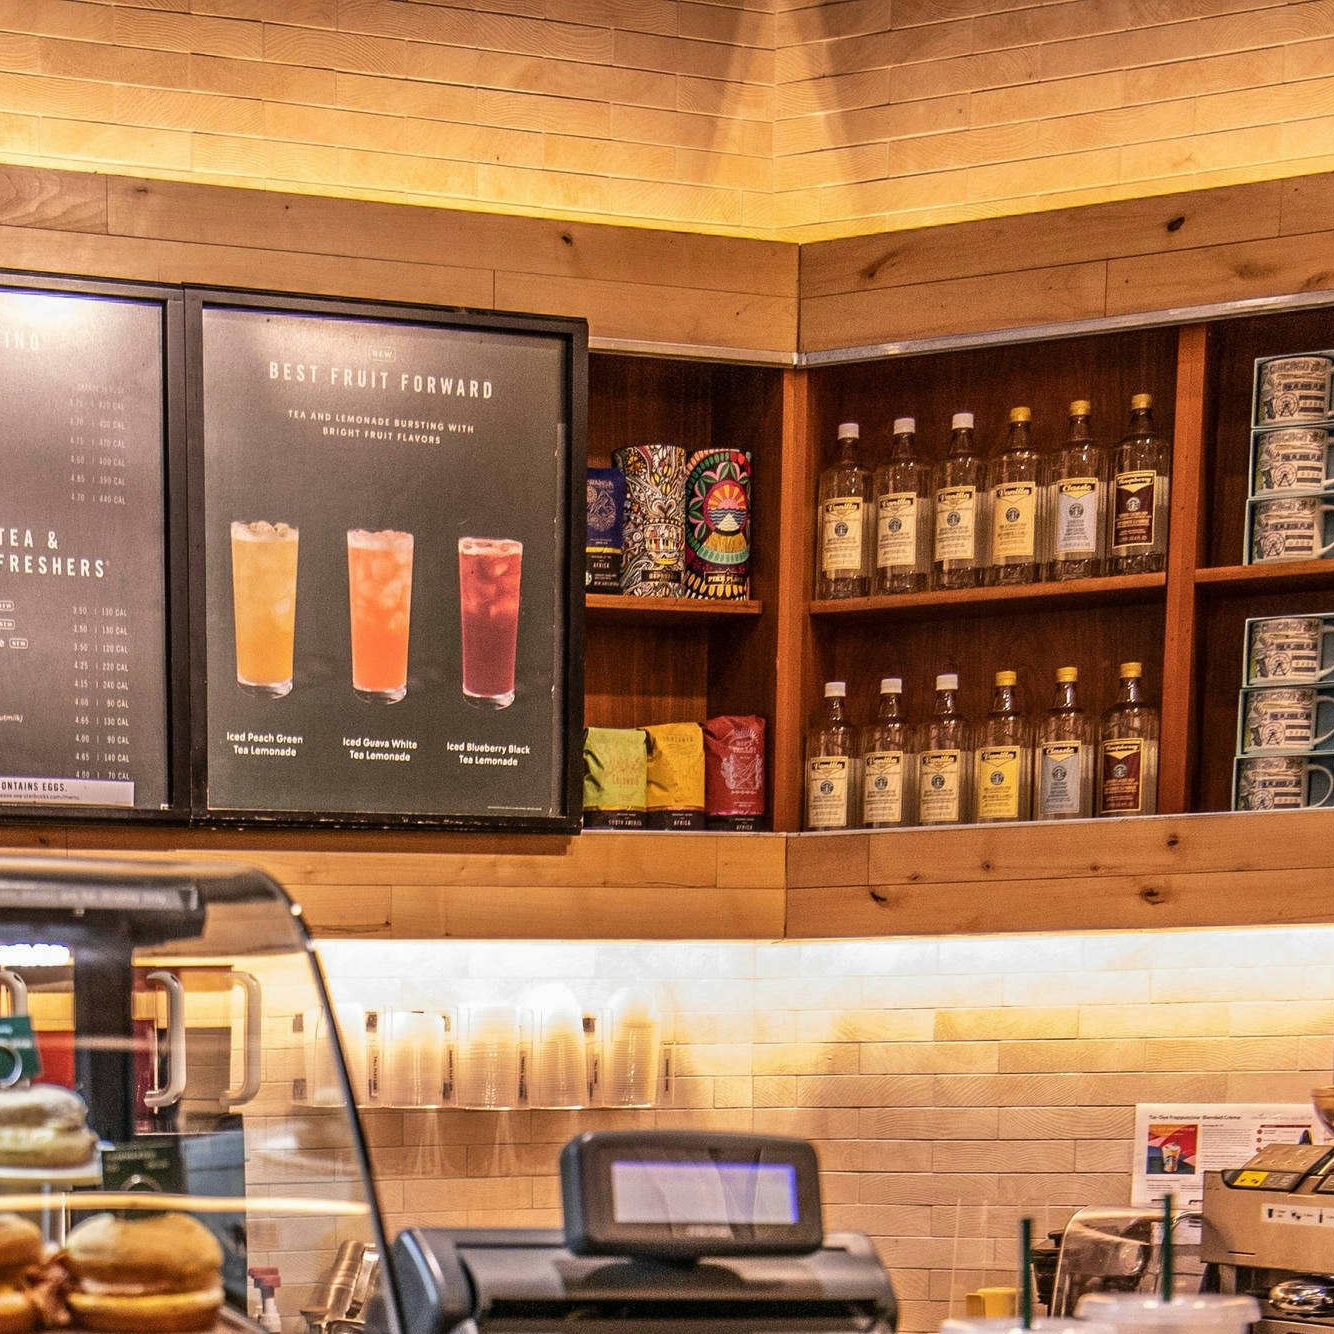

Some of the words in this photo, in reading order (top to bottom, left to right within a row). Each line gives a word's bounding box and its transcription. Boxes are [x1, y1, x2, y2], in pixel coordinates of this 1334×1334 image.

[269, 361, 318, 382] BEST
[330, 368, 388, 389] FRUIT
[401, 374, 492, 398] FORWARD
[288, 408, 306, 419] TEA
[310, 411, 331, 421] AND
[335, 413, 389, 426] LEMONADE
[394, 418, 443, 431] BURSTING
[447, 423, 473, 433] WITH
[322, 425, 360, 437] BRIGHT
[364, 429, 392, 440] FRUIT
[397, 432, 440, 444] FLAVORS
[47, 530, 58, 549] &
[226, 731, 245, 741] Iced
[247, 732, 274, 742] Peach
[275, 733, 303, 744] Green
[342, 736, 361, 746] Iced
[362, 737, 389, 747] Guava
[391, 738, 417, 749] White
[232, 744, 248, 754] Tea
[250, 745, 296, 756] Lemonade
[446, 741, 464, 751] Iced
[466, 742, 506, 755] Blueberry
[508, 744, 530, 754] Black
[349, 749, 364, 759] Tea
[365, 750, 410, 761] Lemonade
[458, 754, 473, 764] Tea
[474, 755, 518, 766] Lemonade
[42, 782, 67, 792] EGGS.
